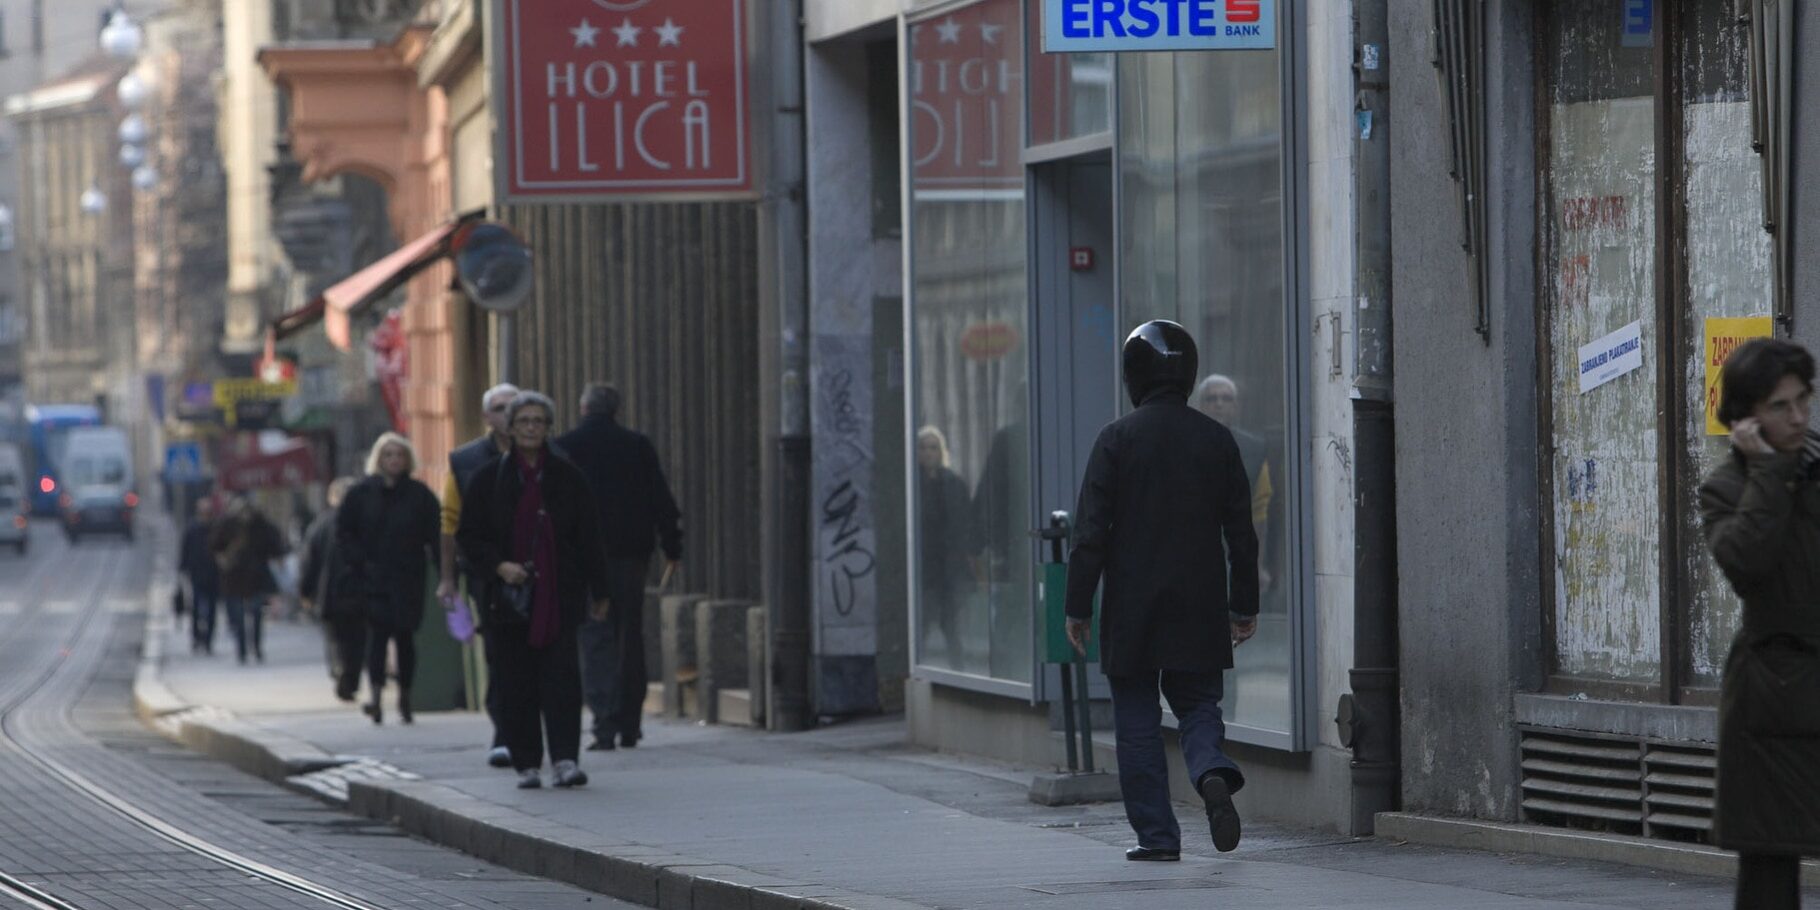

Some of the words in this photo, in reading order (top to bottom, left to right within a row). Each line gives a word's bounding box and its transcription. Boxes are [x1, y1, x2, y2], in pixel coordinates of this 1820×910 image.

[1062, 0, 1216, 38] ERSTE
[1225, 25, 1260, 36] BANK
[546, 60, 709, 98] HOTEL
[549, 99, 709, 171] ILICA
